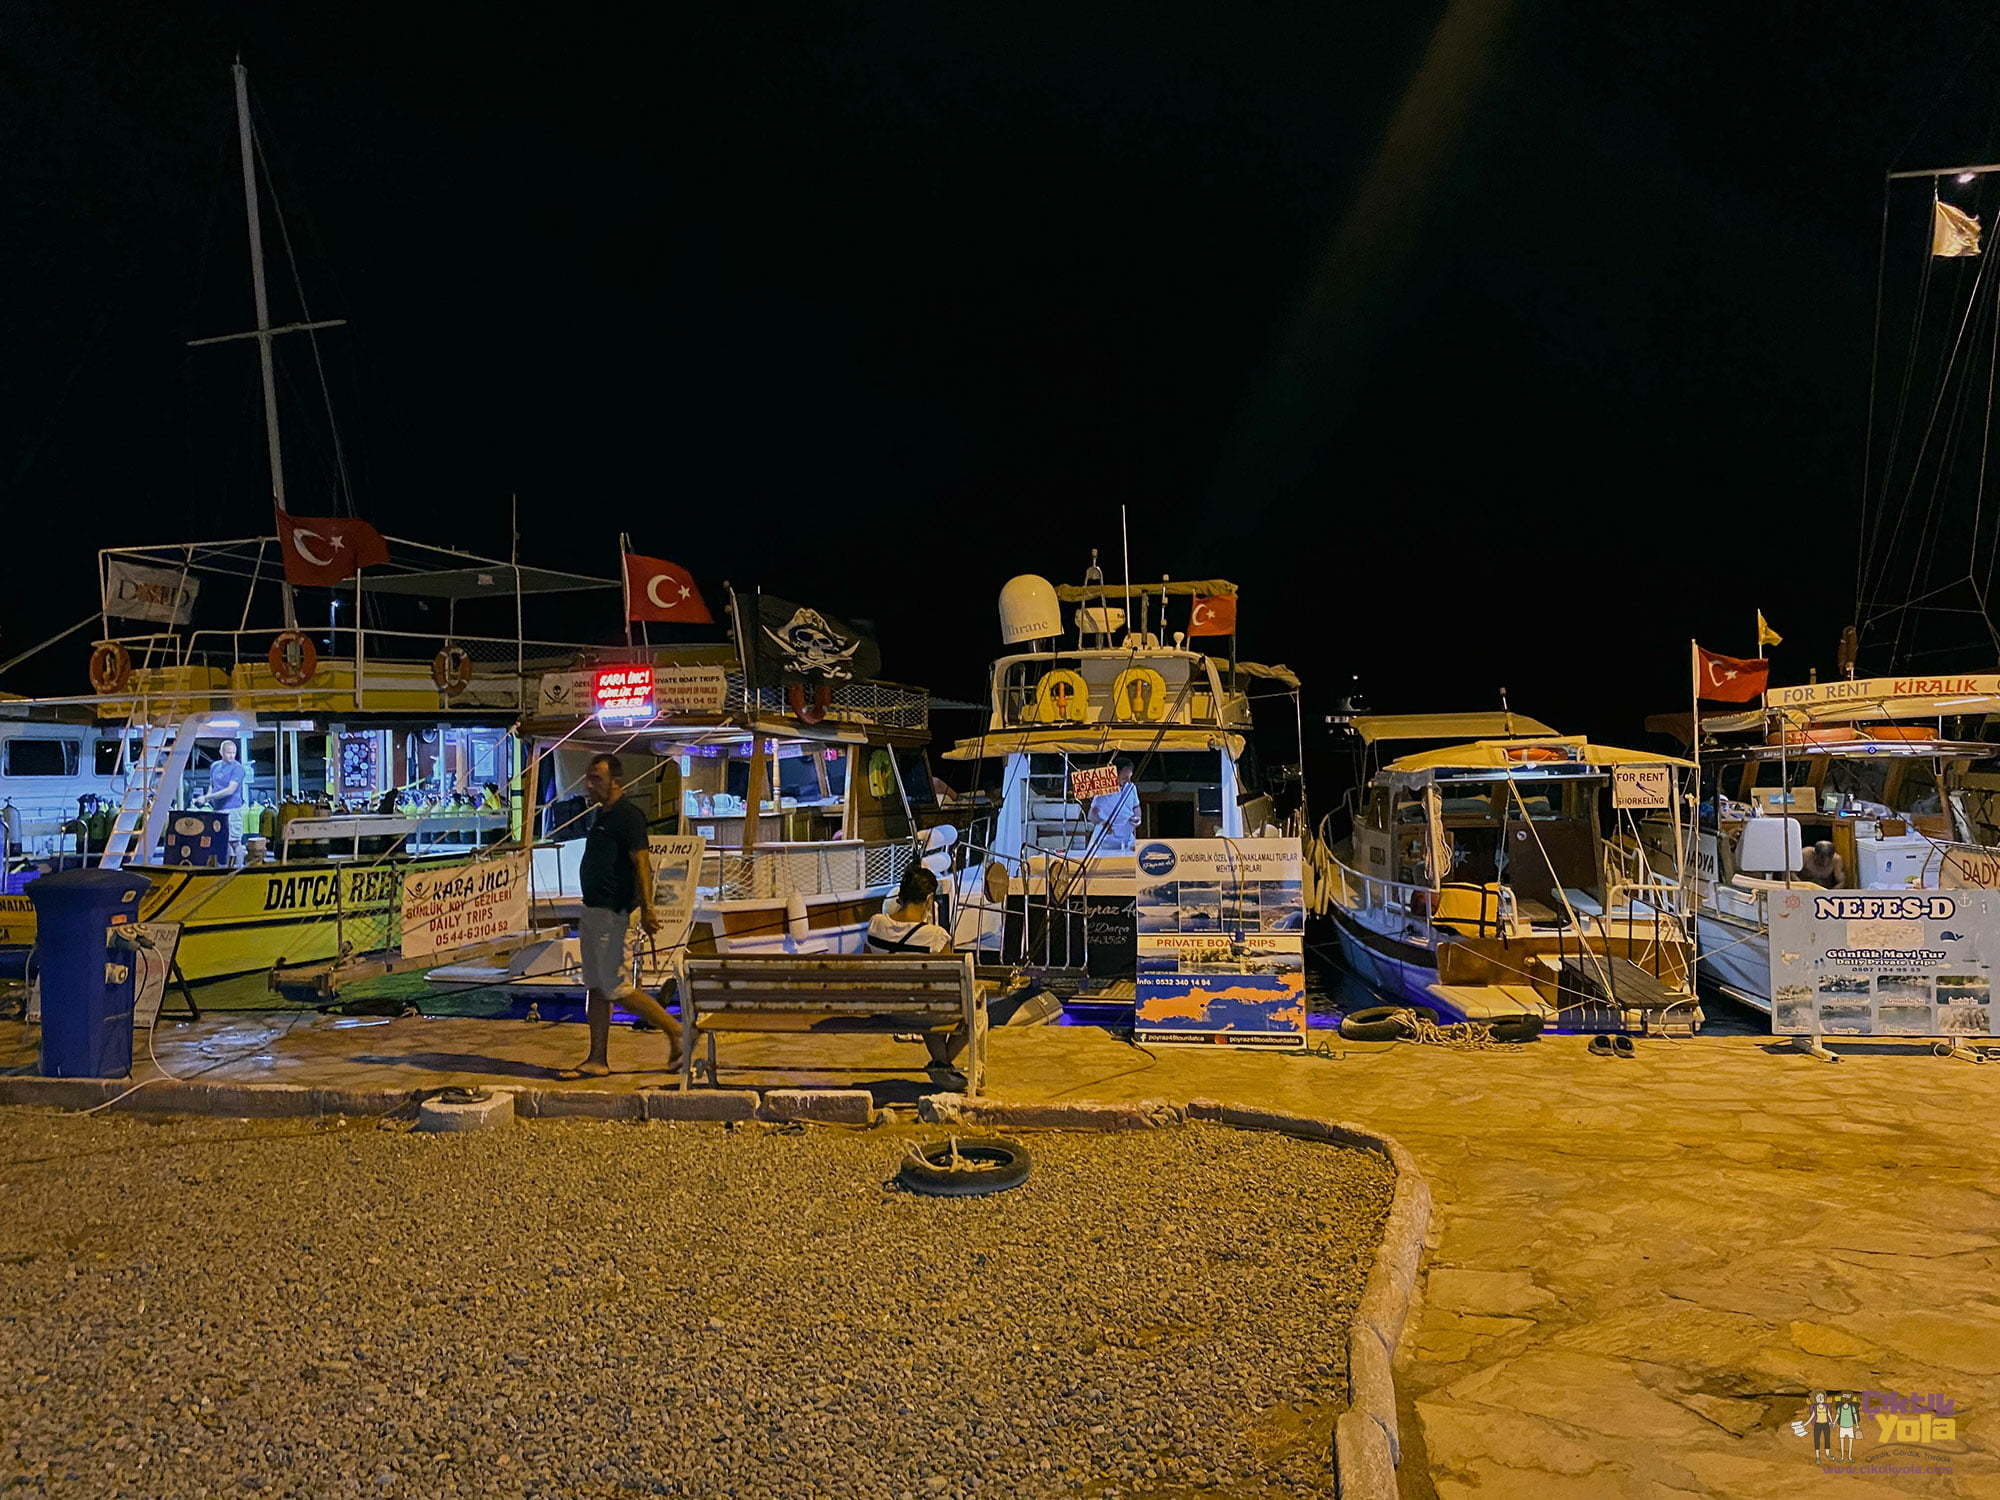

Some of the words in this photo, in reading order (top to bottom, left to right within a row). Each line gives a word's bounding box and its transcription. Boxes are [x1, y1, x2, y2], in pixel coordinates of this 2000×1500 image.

[1784, 687, 1815, 702] FOR
[1826, 682, 1872, 698] RENT
[1094, 777, 1117, 790] RENT
[1616, 773, 1635, 782] FOR
[1639, 772, 1664, 781] RENT
[647, 844, 667, 856] ARA
[1962, 859, 2000, 887] DADY
[1815, 897, 1956, 920] NEFES-D
[430, 915, 461, 932] DAILY
[467, 908, 493, 924] TRIPS
[1207, 939, 1236, 948] BOA
[1248, 939, 1276, 947] RIPS
[1826, 949, 1880, 959] Günlük
[1919, 951, 1946, 959] Tur
